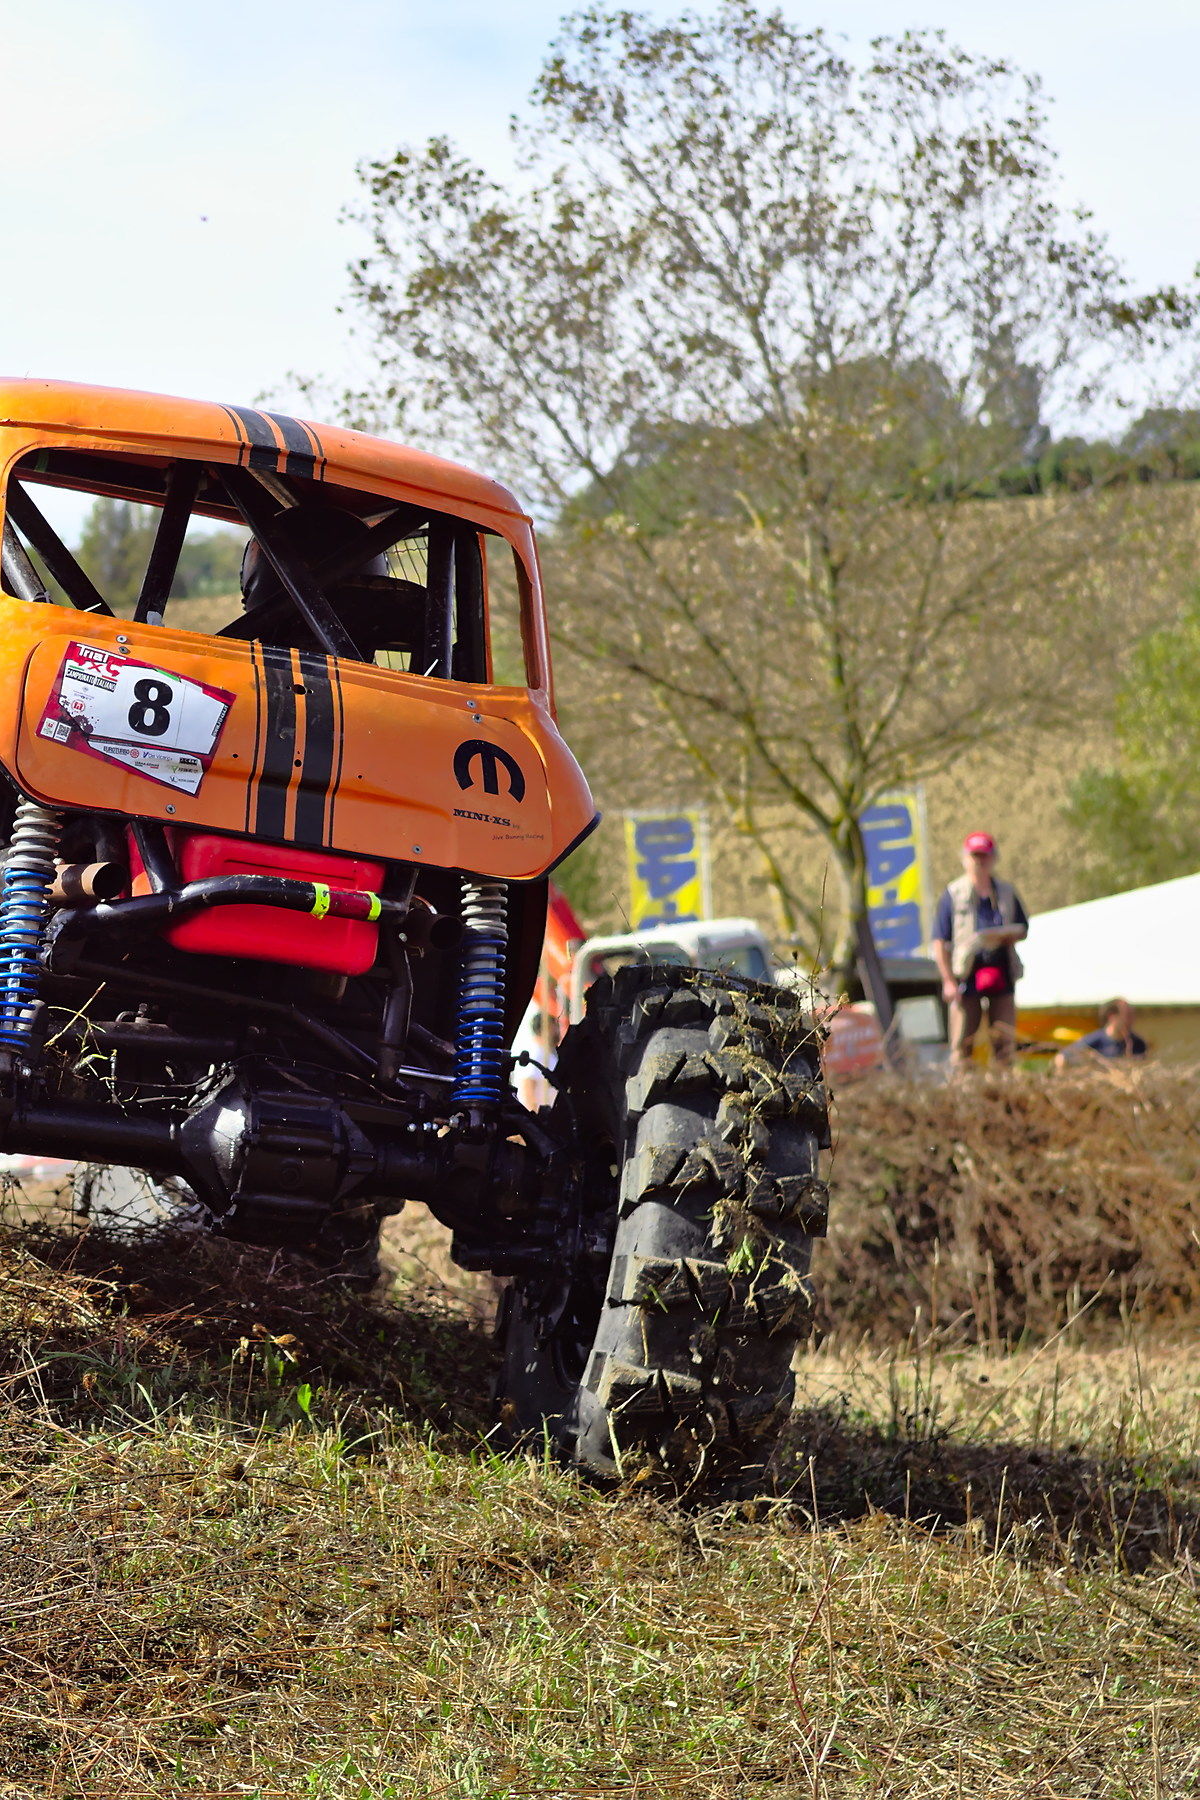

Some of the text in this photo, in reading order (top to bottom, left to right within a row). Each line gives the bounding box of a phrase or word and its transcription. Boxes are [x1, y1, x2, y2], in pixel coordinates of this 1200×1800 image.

[66, 669, 116, 691] CAMPIONATO ITALIANO
[127, 678, 174, 737] 8
